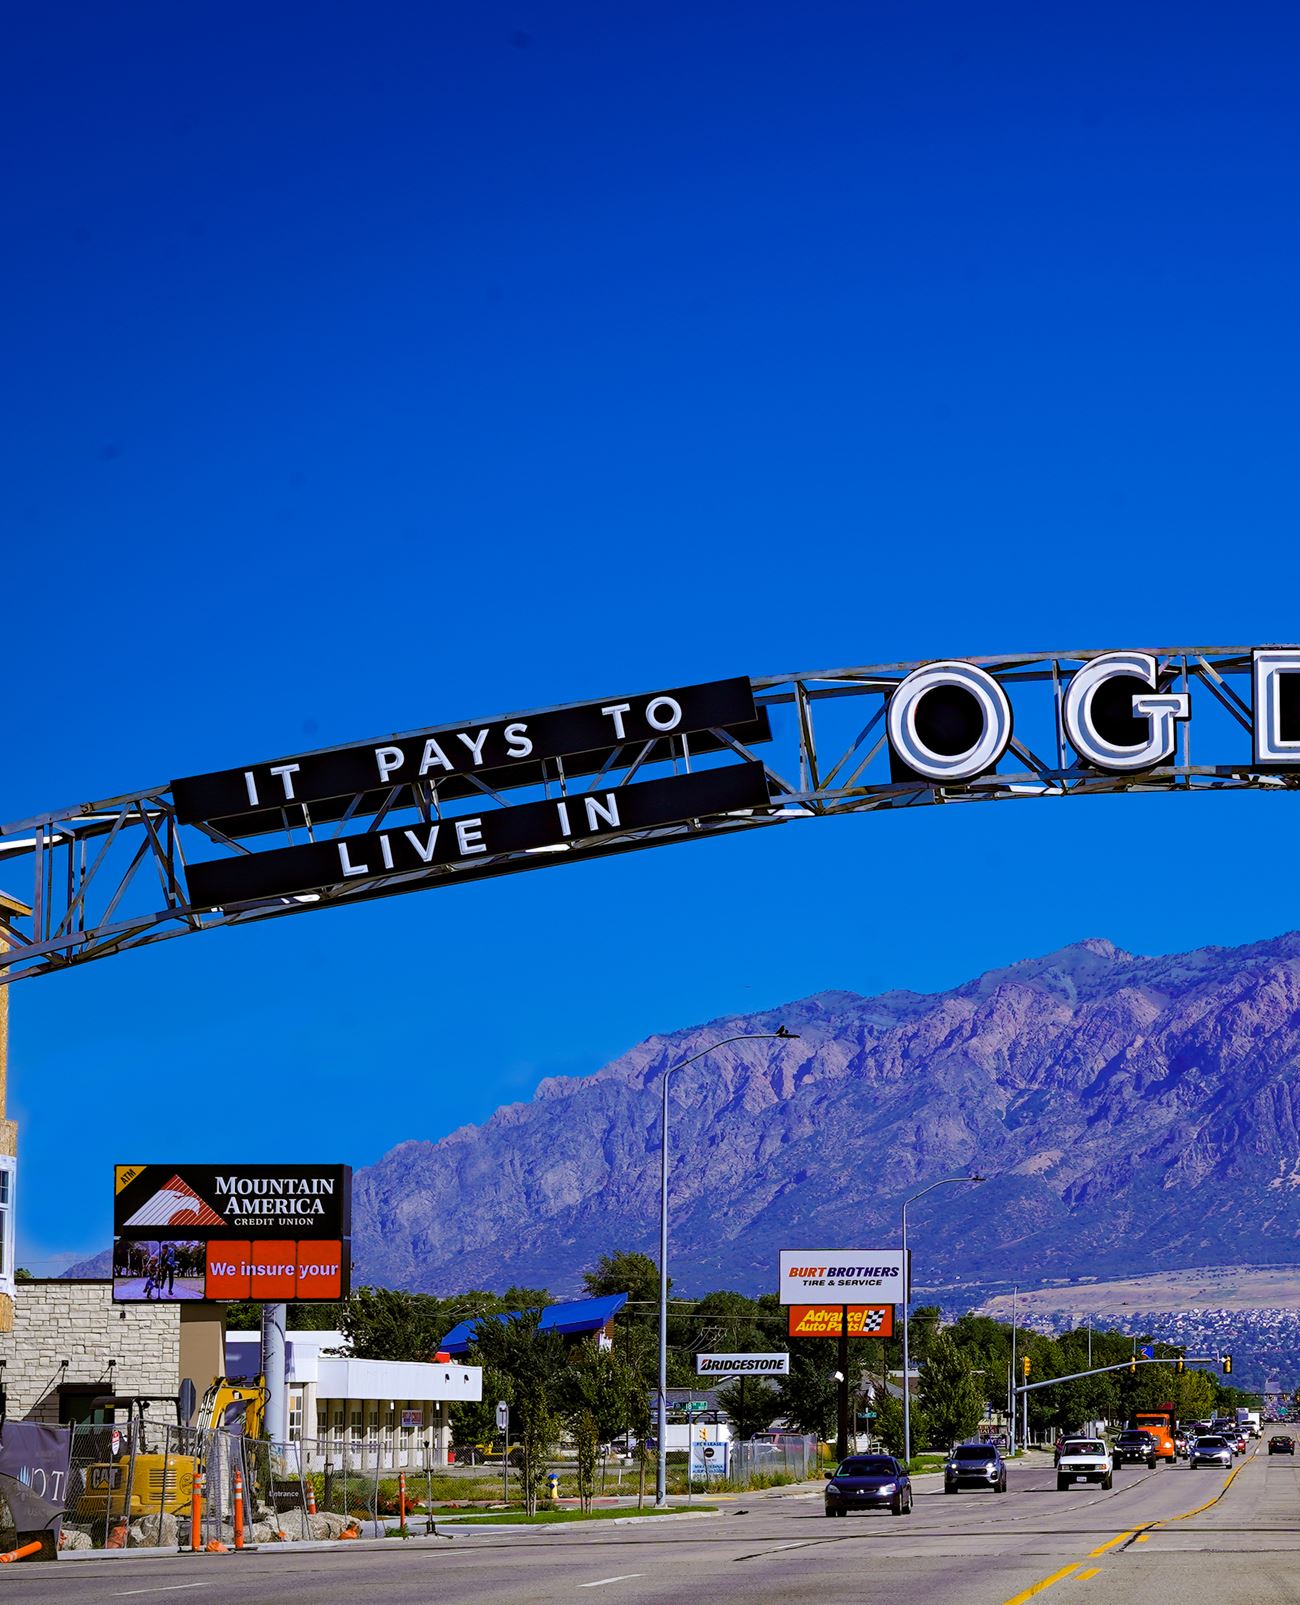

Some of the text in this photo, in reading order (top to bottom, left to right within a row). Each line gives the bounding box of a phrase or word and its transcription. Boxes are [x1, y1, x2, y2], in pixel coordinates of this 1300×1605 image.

[245, 696, 682, 806] IT PAYS TO
[337, 793, 621, 877] LIVE IN
[120, 1169, 137, 1185] ATM
[215, 1176, 335, 1195] MOUNTAIN
[223, 1196, 325, 1215] AMERICA
[234, 1218, 314, 1226] CREDIT UNION
[210, 1261, 339, 1280] We insure your
[789, 1267, 899, 1277] BURT BROTHERS
[795, 1321, 827, 1332] Auto
[701, 1359, 785, 1371] BRIDGESTONE
